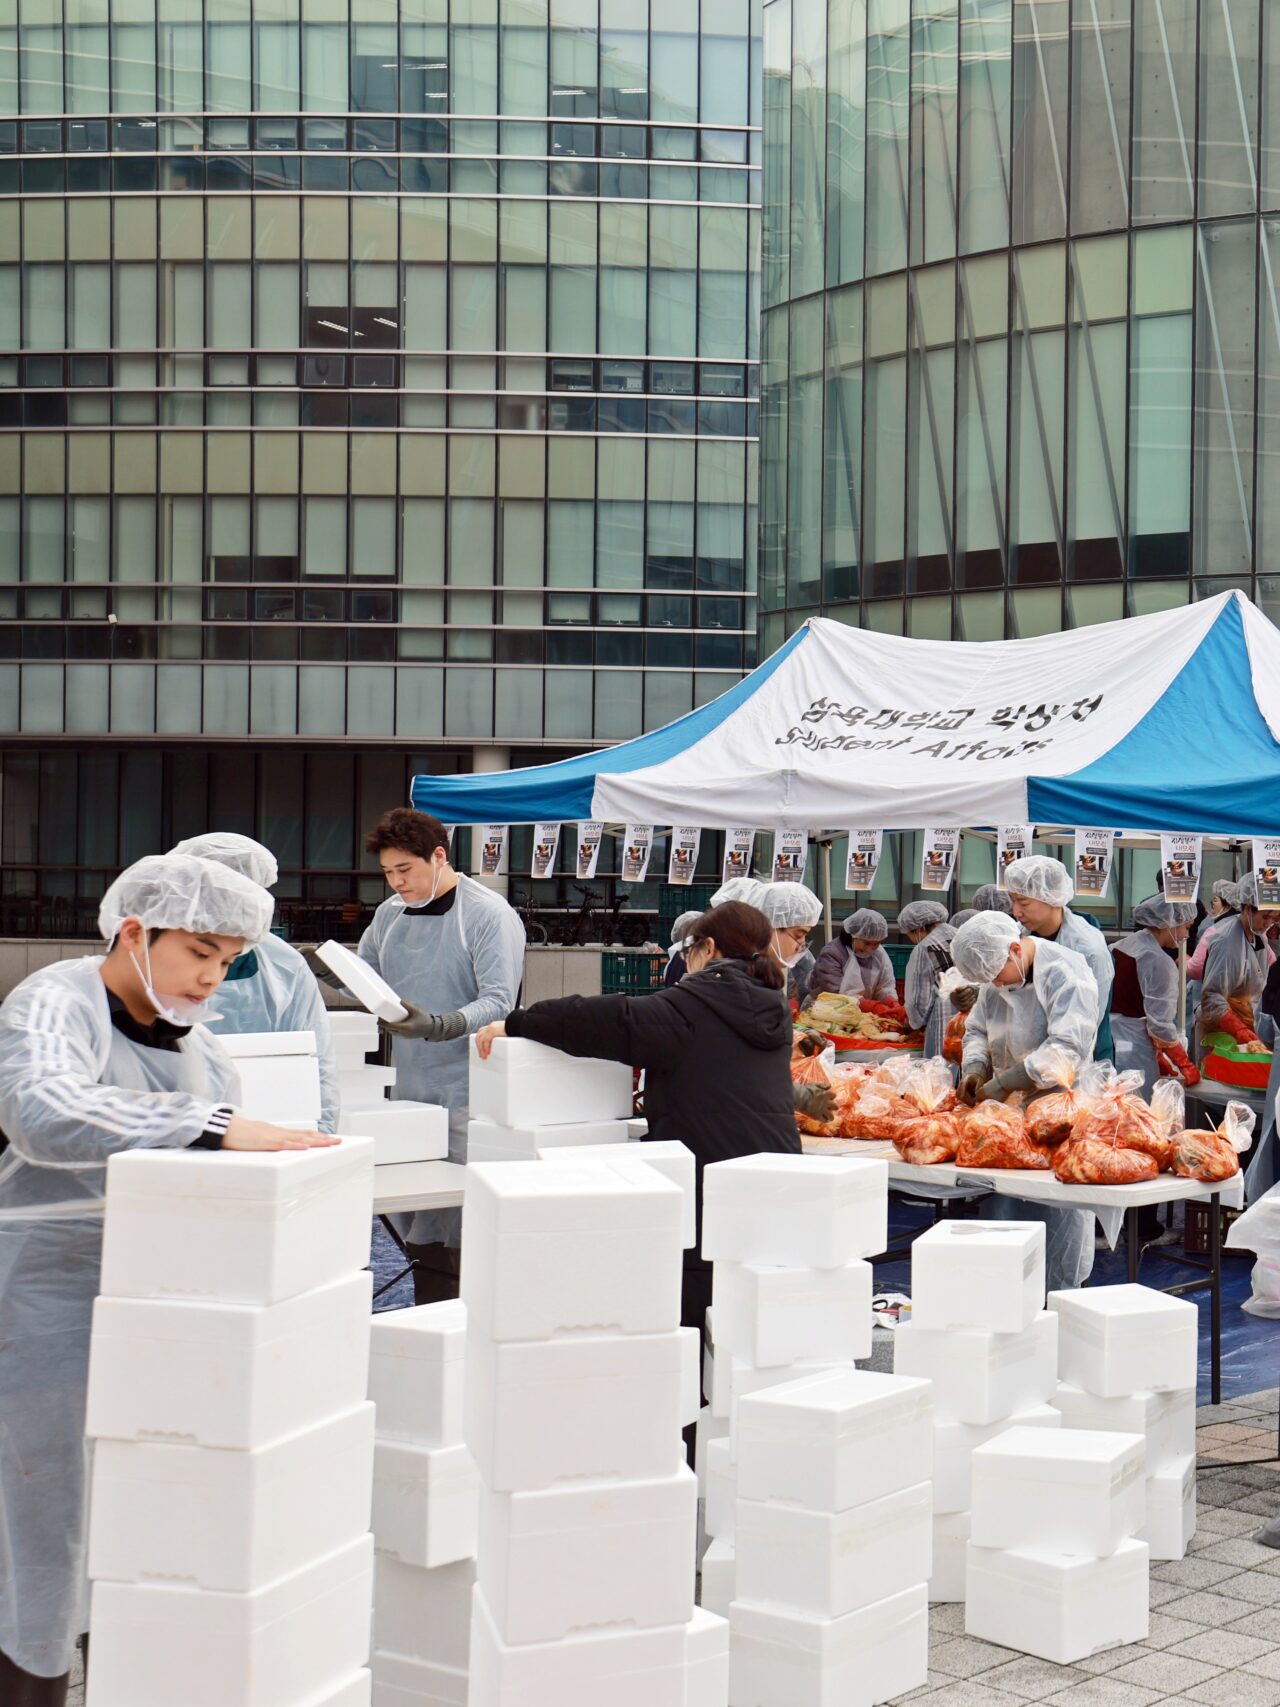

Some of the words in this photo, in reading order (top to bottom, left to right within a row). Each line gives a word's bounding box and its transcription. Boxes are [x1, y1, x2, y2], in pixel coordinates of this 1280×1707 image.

[801, 697, 976, 731] 삼육대학교
[986, 694, 1103, 732] 학생처
[774, 726, 914, 751] Student
[910, 738, 1053, 761] Affairs
